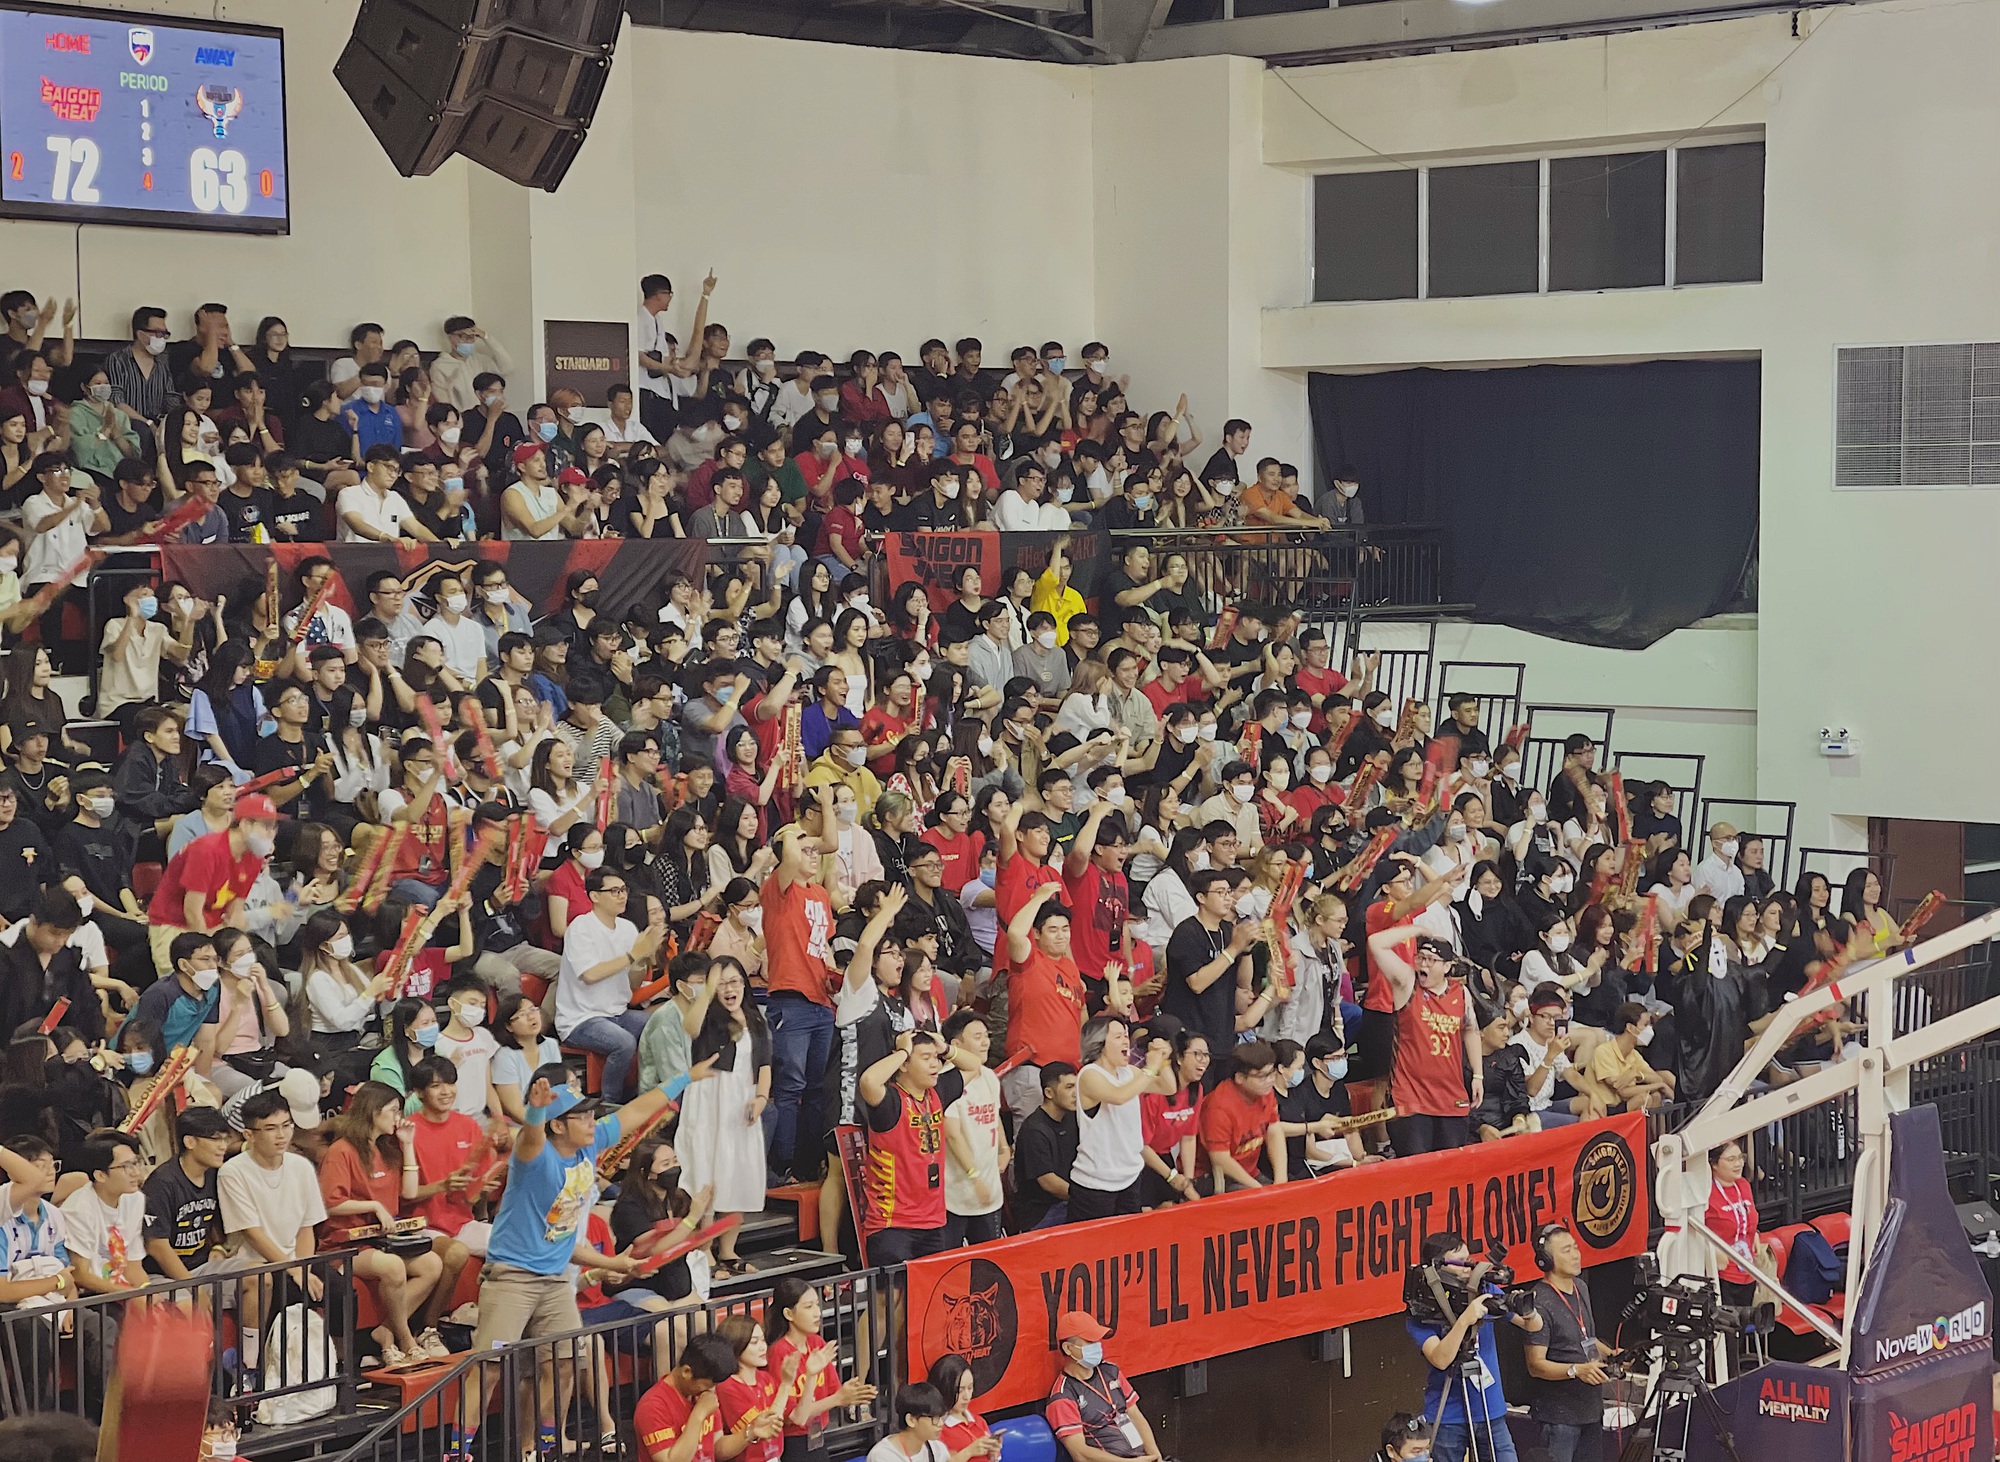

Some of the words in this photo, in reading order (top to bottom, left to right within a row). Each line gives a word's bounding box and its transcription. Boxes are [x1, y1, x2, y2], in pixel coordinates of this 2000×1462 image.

[45, 33, 91, 54] HOME
[195, 47, 235, 67] AWAY
[119, 72, 168, 92] PERIOD
[140, 99, 149, 118] 1
[141, 122, 151, 141] 2
[10, 151, 24, 181] 2
[46, 136, 100, 203] 72
[142, 172, 153, 190] 4
[190, 147, 248, 214] 63
[259, 169, 273, 198] 0
[555, 356, 610, 371] STANDARD
[899, 531, 983, 563] SAIGON
[1203, 1216, 1322, 1315] NEVER
[1335, 1191, 1433, 1286] FIGHT
[1665, 1299, 1675, 1312] 4
[1760, 1378, 1804, 1404] ALL
[1806, 1384, 1830, 1407] IN
[1890, 1402, 1977, 1462] SAIGON
